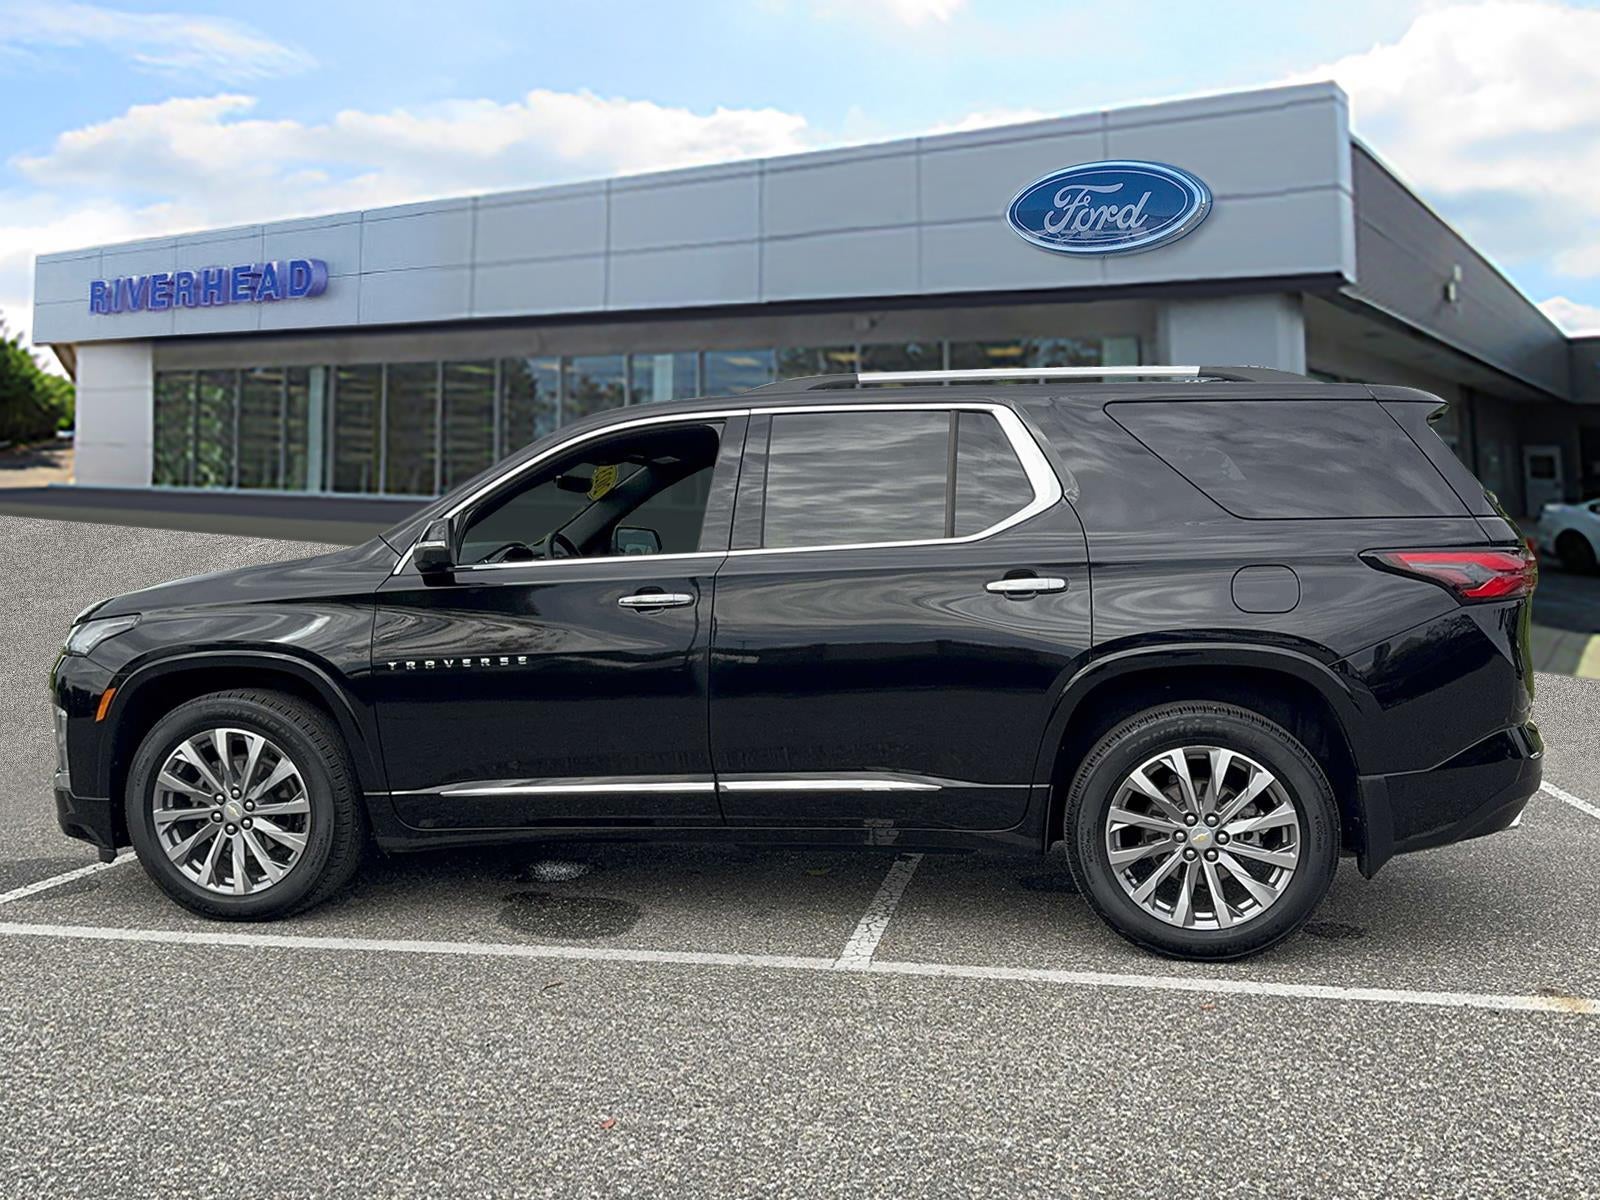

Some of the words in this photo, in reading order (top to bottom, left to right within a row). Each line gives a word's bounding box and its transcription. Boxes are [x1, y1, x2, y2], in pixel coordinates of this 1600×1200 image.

[1043, 183, 1152, 234] Ford
[89, 258, 320, 316] RIVERHEAD
[387, 656, 527, 671] TRAVERSE
